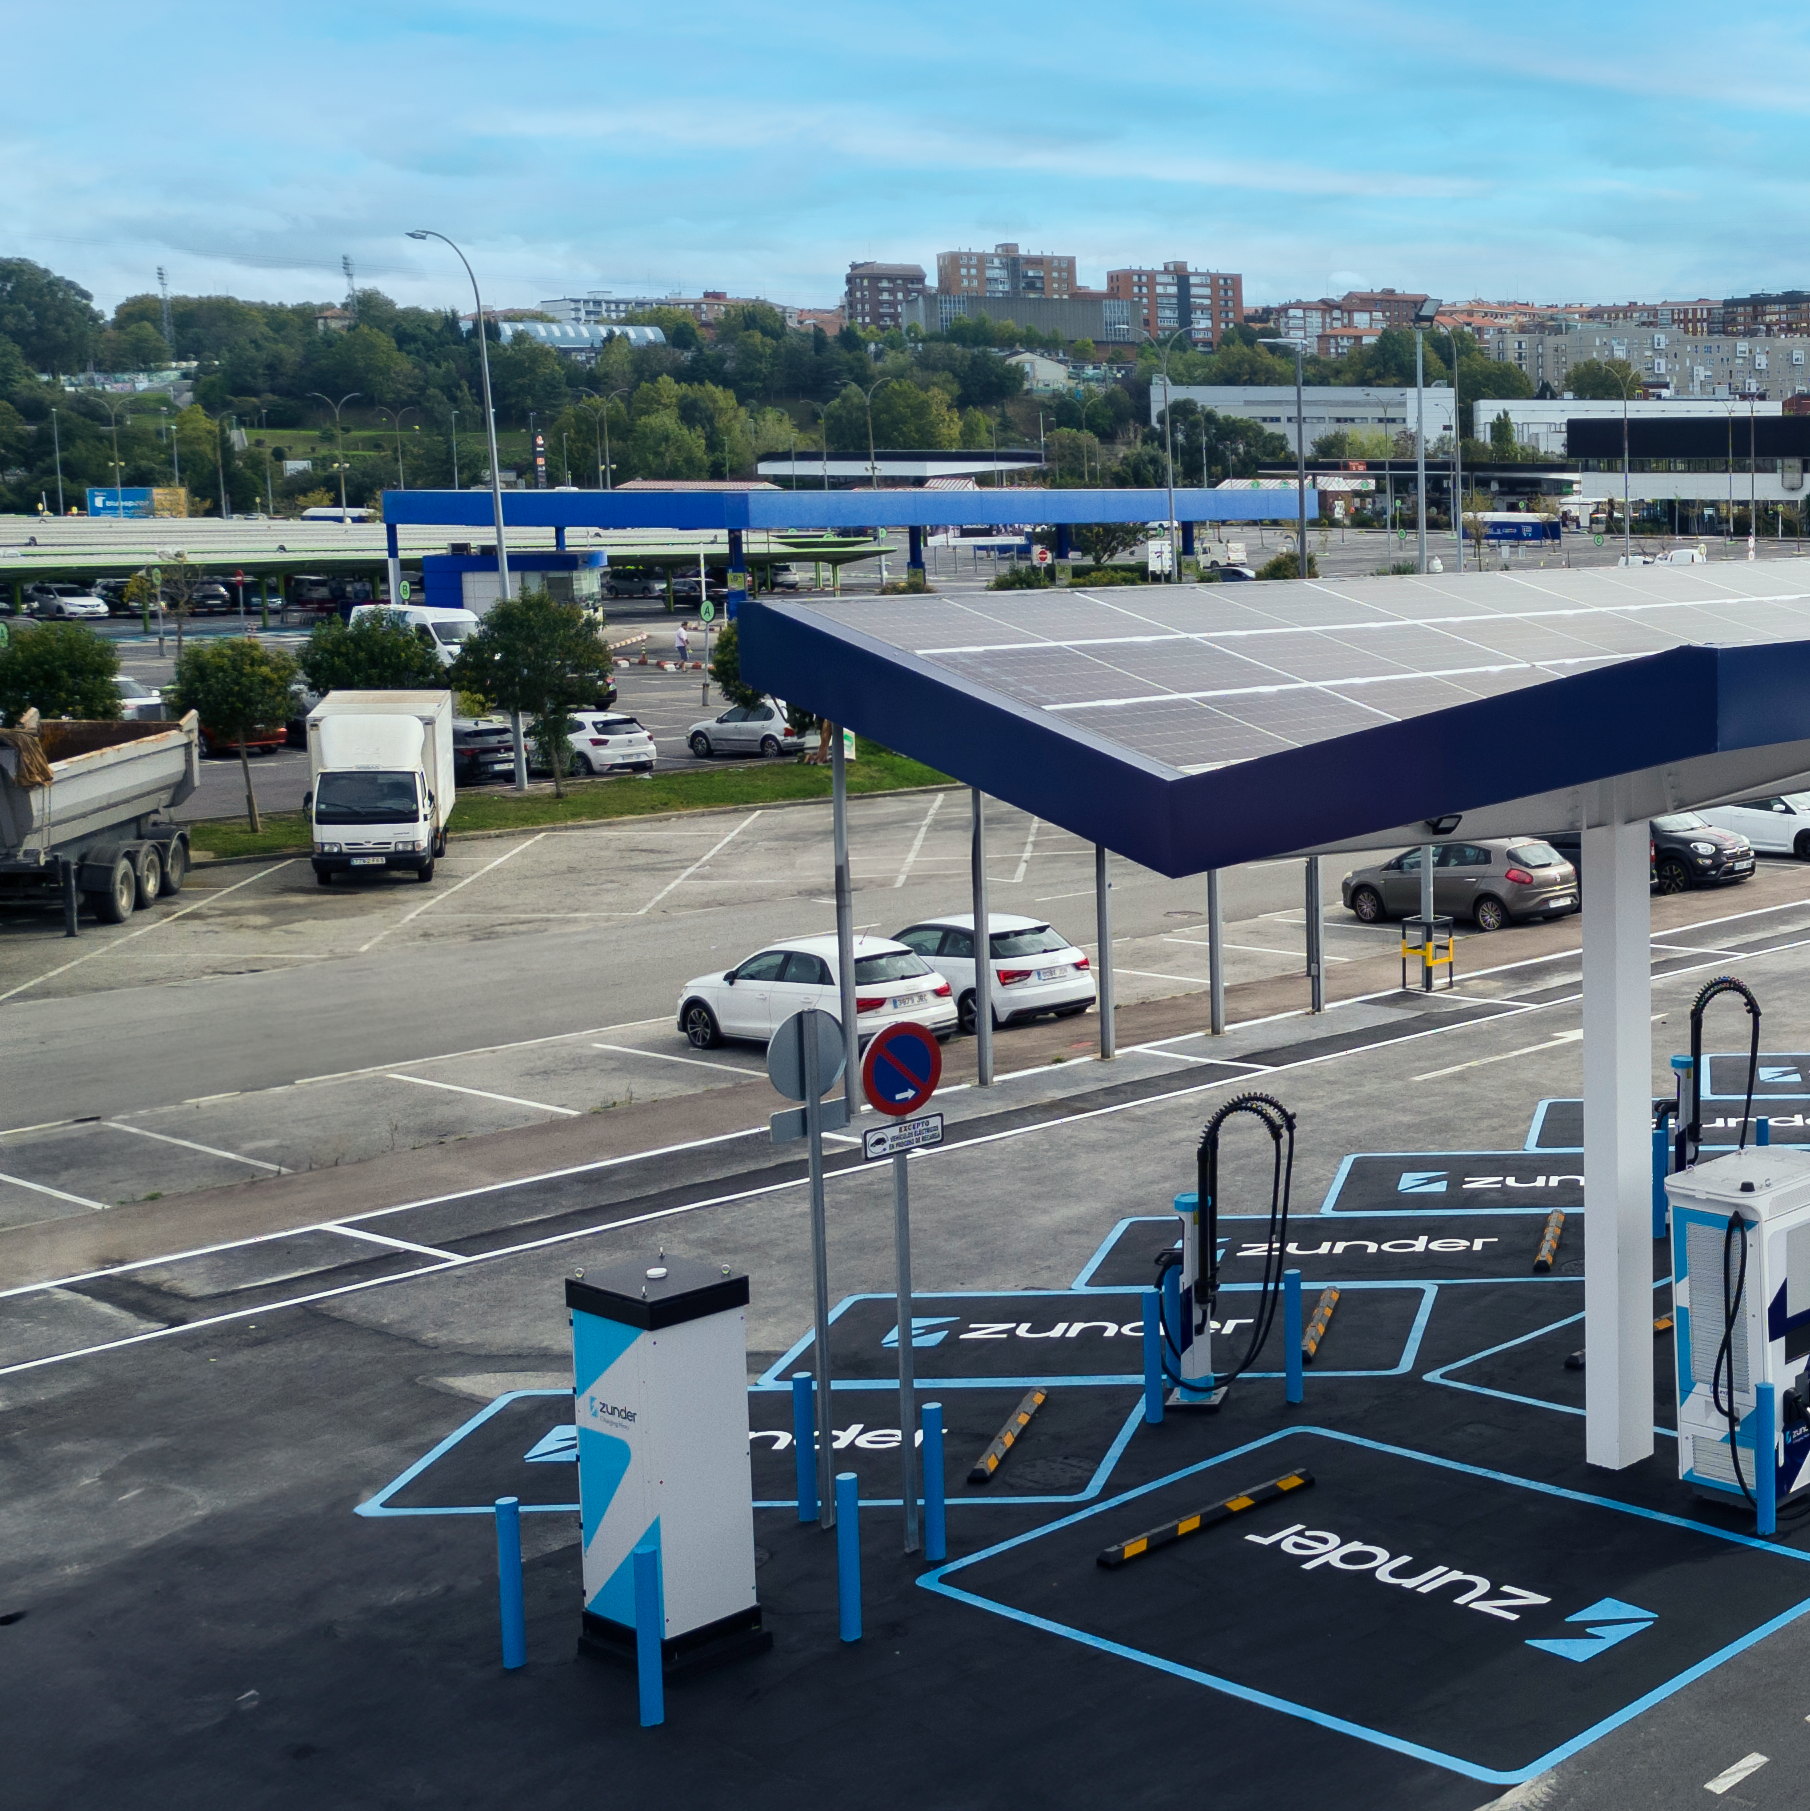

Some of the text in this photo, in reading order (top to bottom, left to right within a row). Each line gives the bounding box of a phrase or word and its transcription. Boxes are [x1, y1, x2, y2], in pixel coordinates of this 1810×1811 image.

[899, 1120, 930, 1133] EXCEPTO
[1462, 1175, 1584, 1188] zun
[1236, 1235, 1499, 1256] zunder
[599, 1401, 637, 1423] zunder
[1244, 1524, 1552, 1620] zunder
